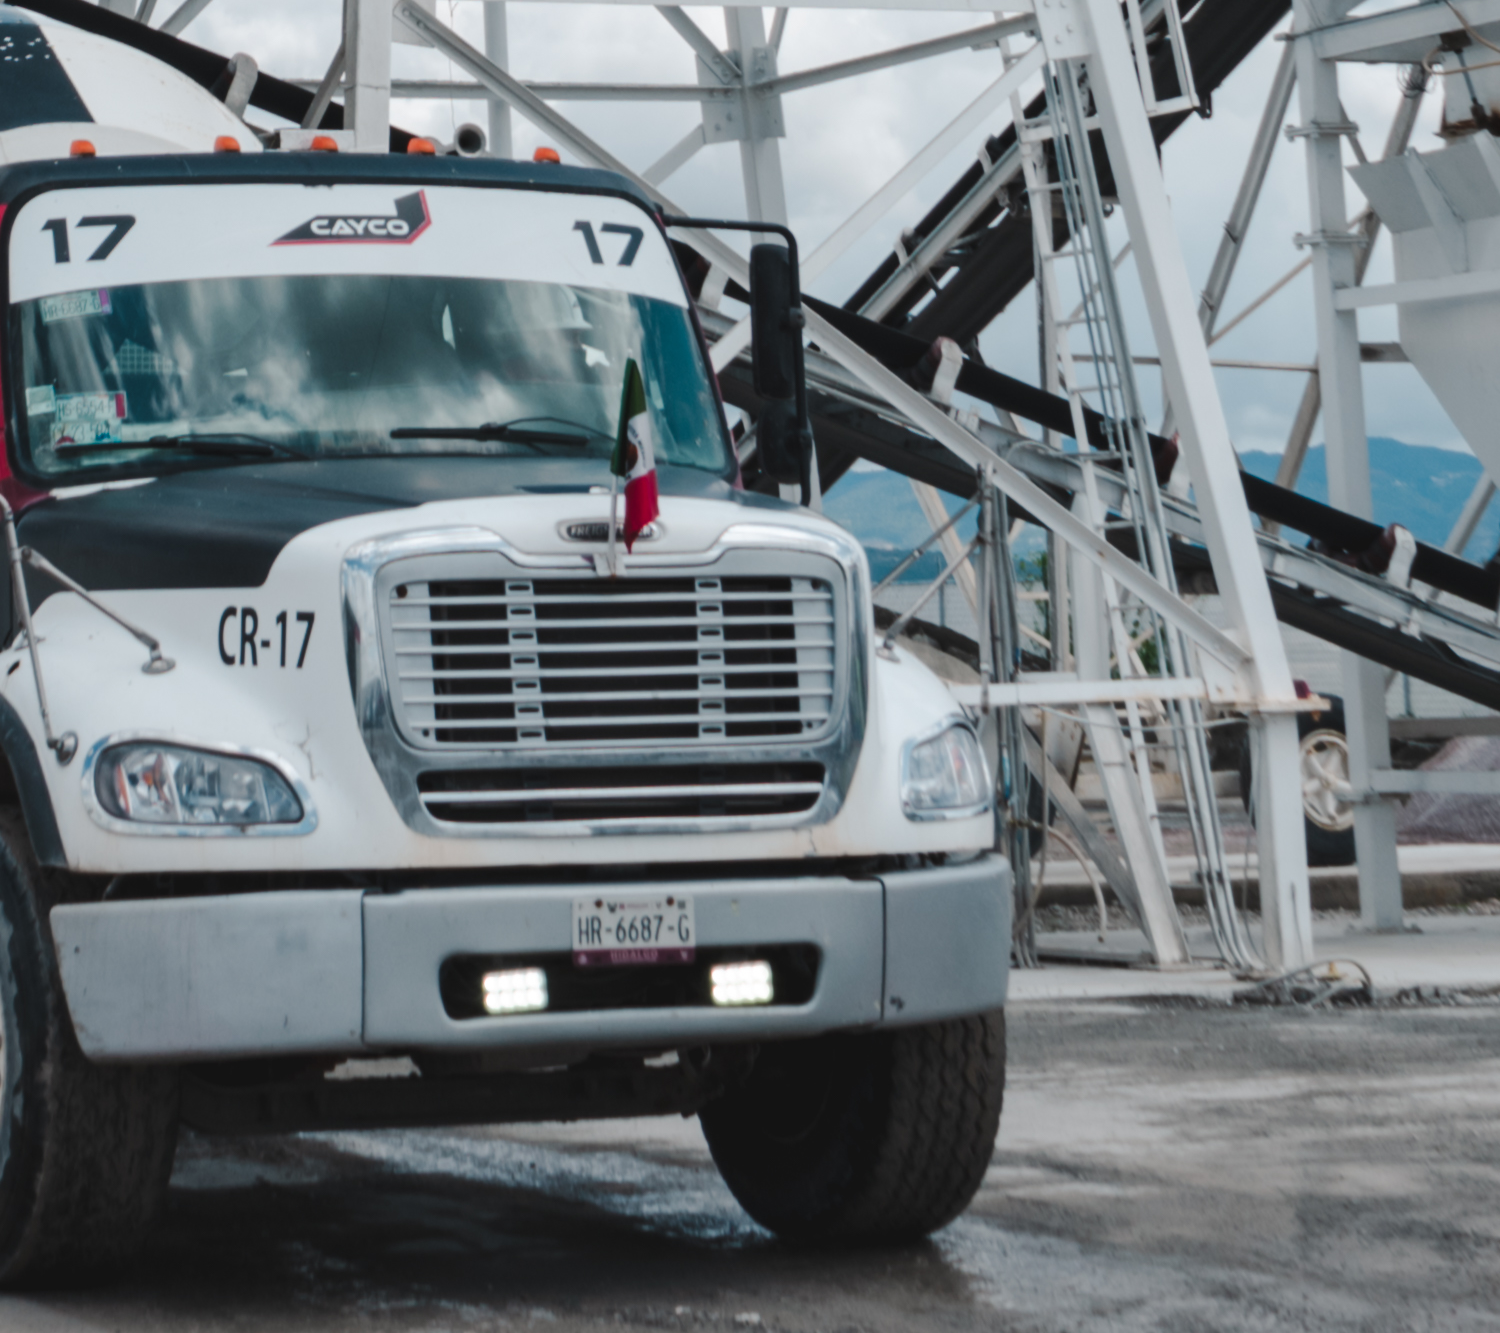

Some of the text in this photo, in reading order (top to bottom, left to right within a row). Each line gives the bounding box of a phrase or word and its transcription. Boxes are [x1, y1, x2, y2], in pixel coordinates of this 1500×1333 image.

[40, 213, 137, 265] 17
[309, 217, 410, 237] CAYCO
[571, 220, 645, 267] 17
[217, 605, 316, 669] CR-17
[578, 913, 691, 945] HR-6687-G
